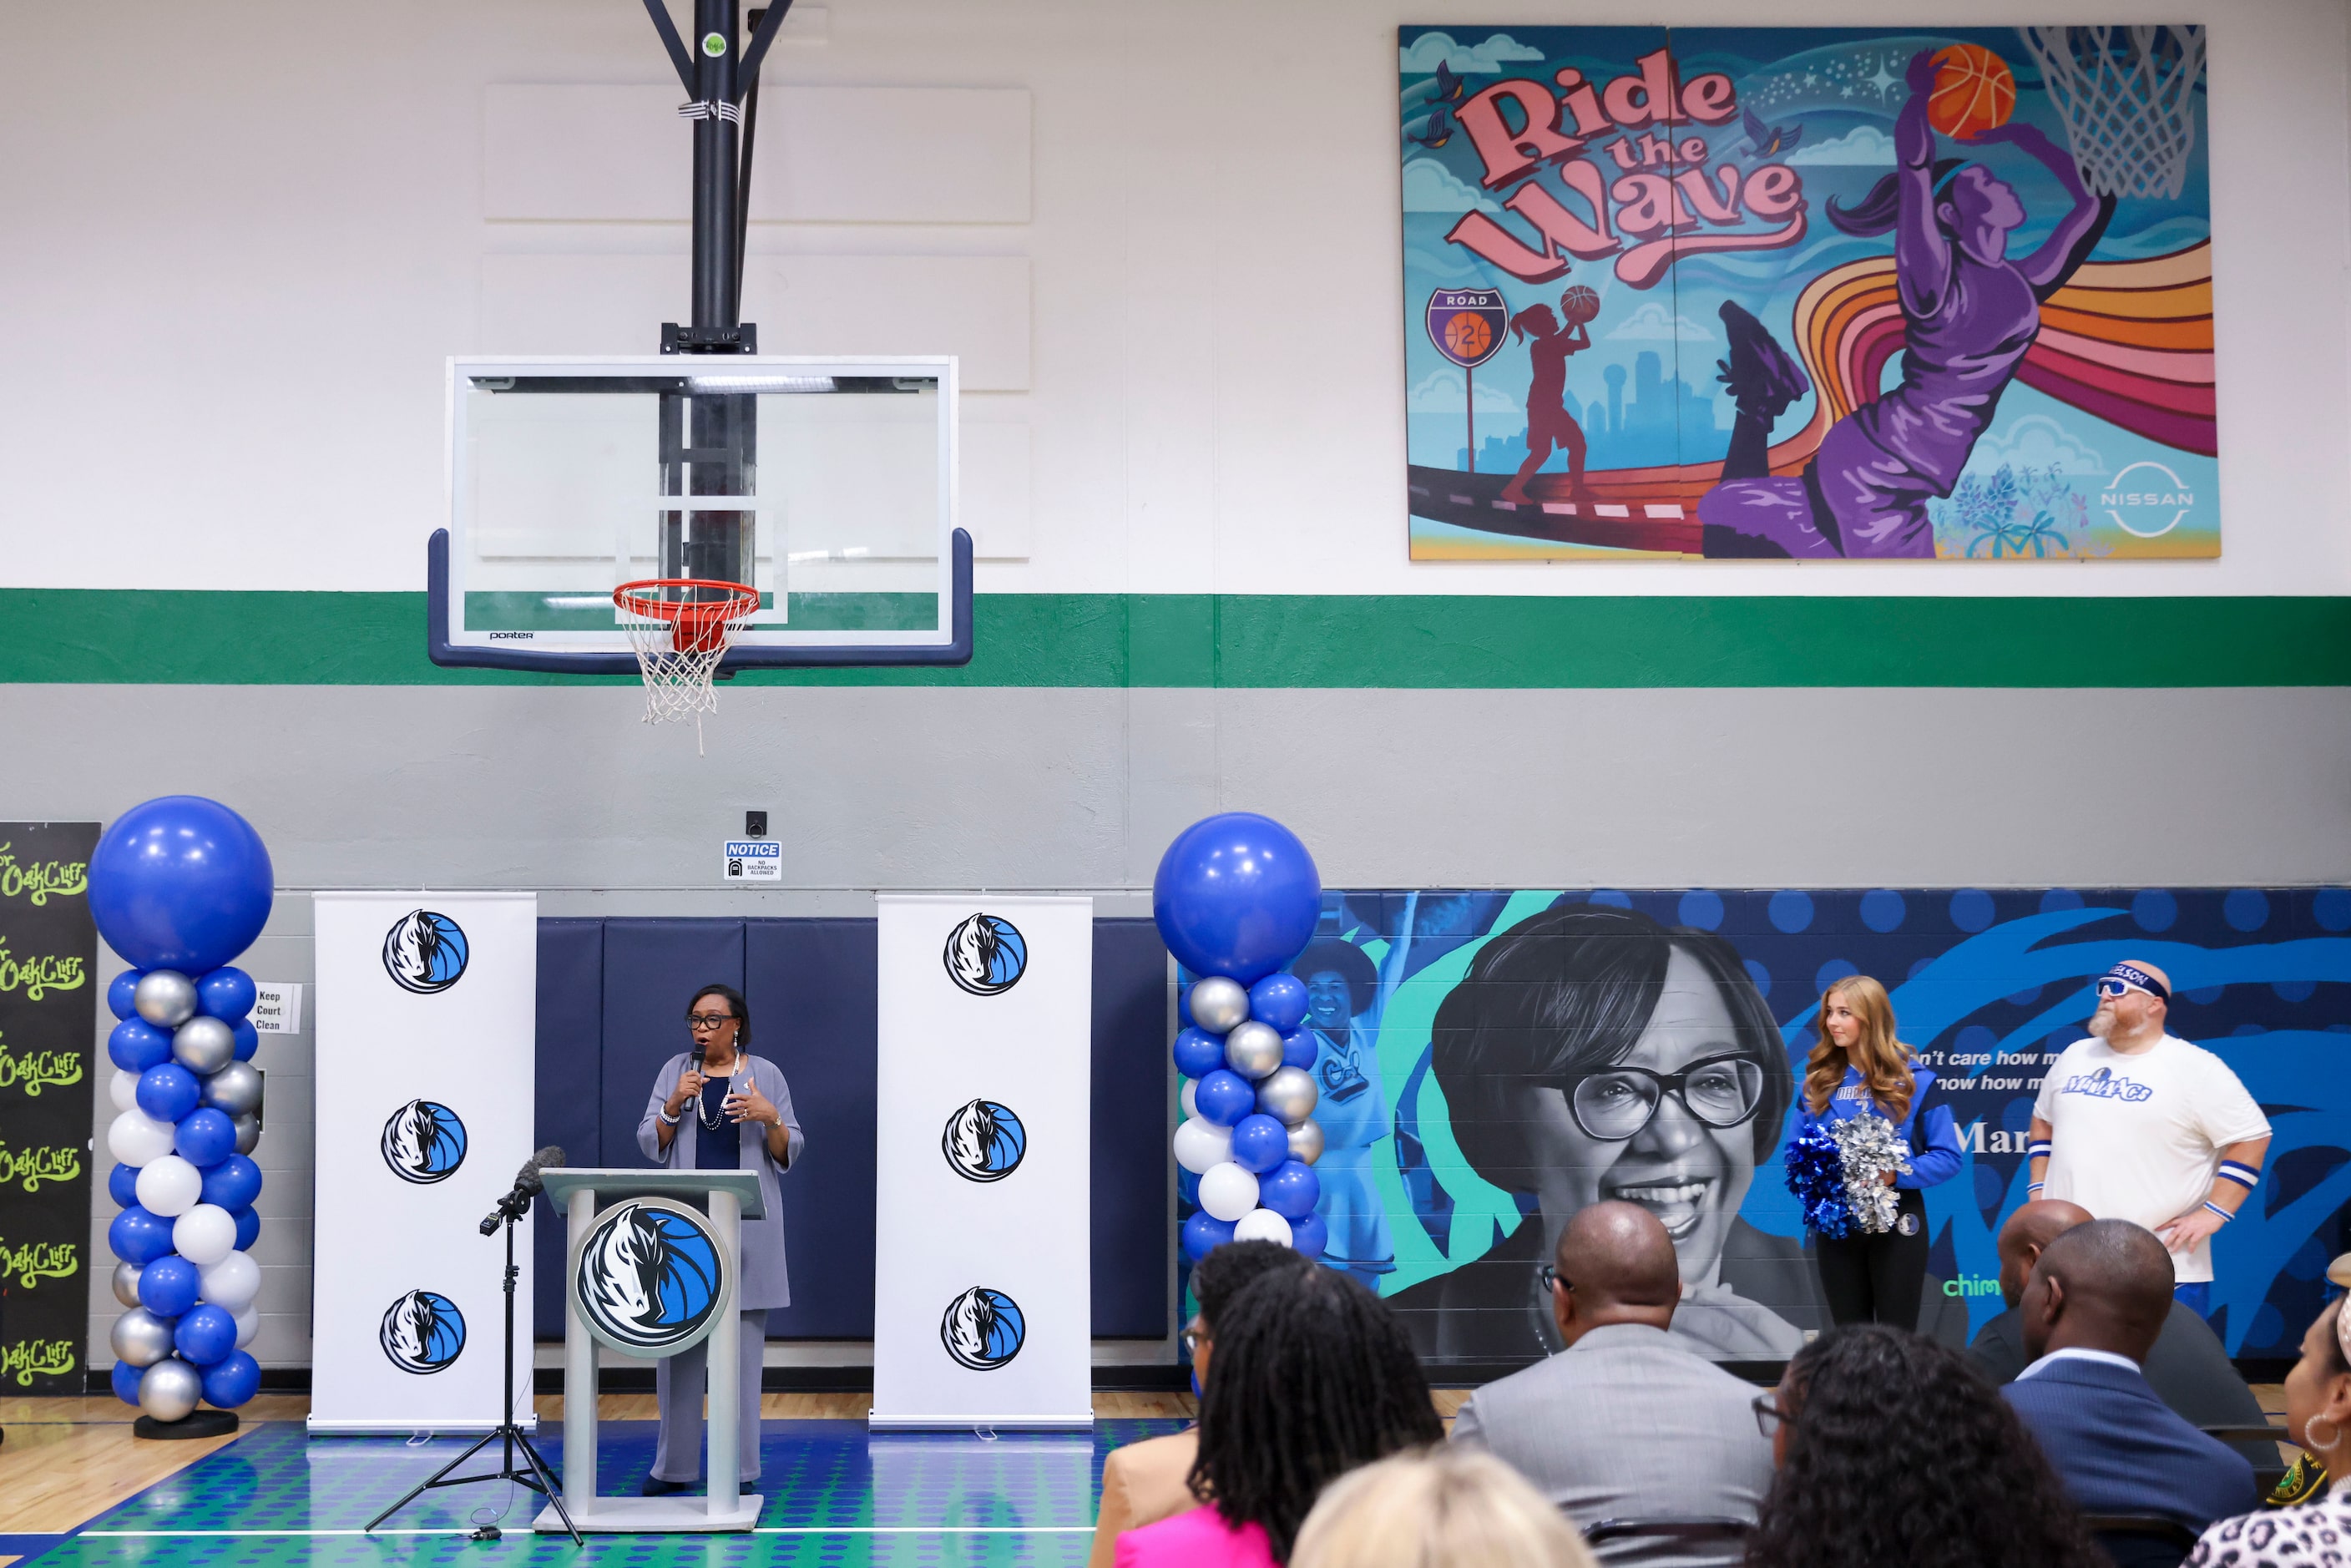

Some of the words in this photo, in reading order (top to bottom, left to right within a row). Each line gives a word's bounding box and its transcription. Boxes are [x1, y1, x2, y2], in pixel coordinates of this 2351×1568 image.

[1454, 47, 1736, 190] Ride
[1605, 135, 1708, 169] the
[1444, 159, 1807, 289] Wave
[1447, 296, 1487, 306] ROAD
[1461, 326, 1474, 345] 2
[2101, 494, 2193, 505] NISSAN
[728, 844, 778, 856] NOTICE
[260, 991, 281, 1002] Keep
[257, 1005, 281, 1015] Court
[256, 1019, 280, 1029] Clean
[1913, 1050, 1944, 1065] n't
[1949, 1053, 1992, 1065] care
[1996, 1050, 2038, 1065] how
[1936, 1078, 1977, 1090] now
[1980, 1075, 2023, 1090] how
[1954, 1122, 2030, 1154] Mar
[1943, 1273, 2001, 1297] chim
